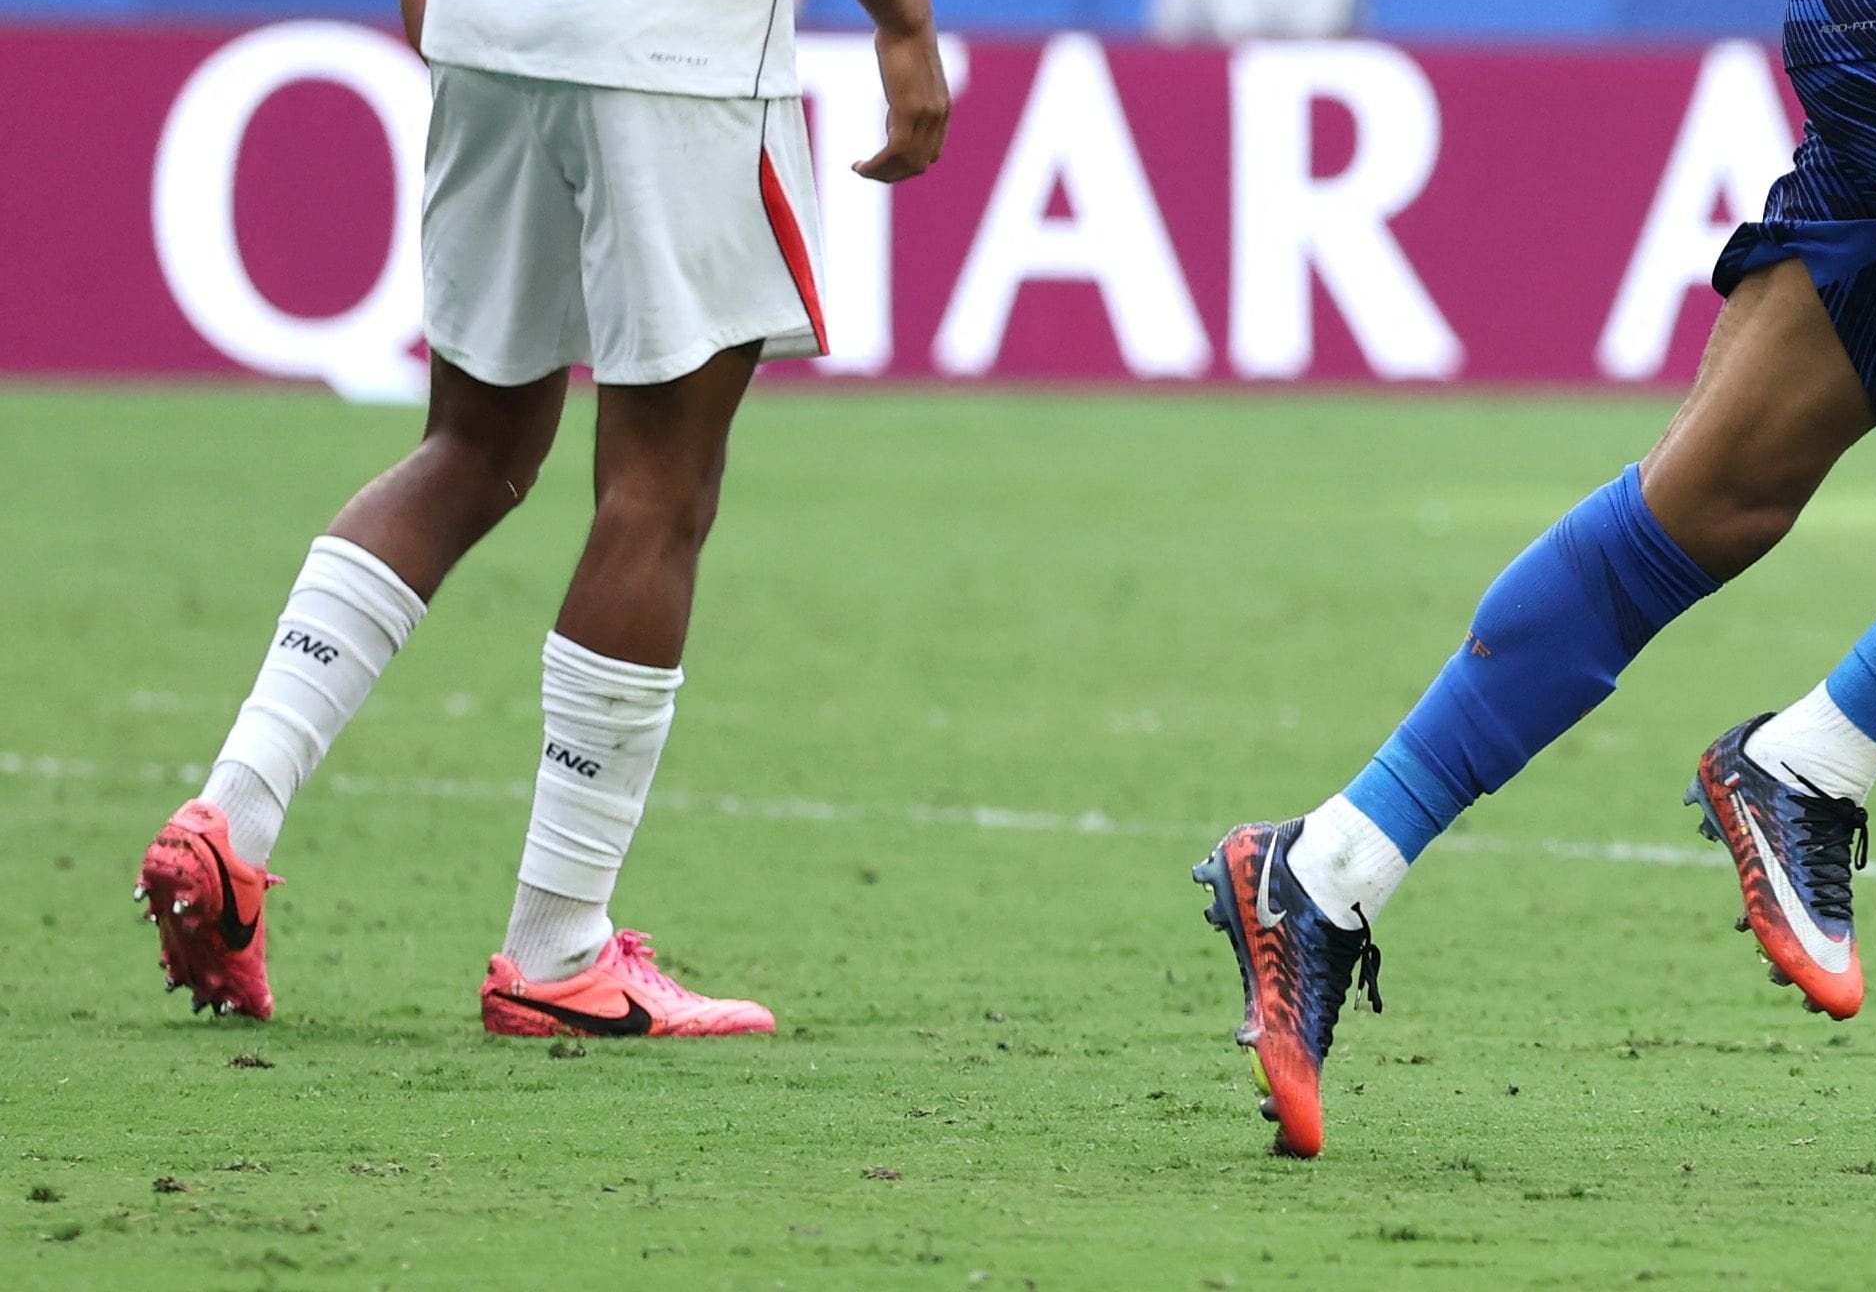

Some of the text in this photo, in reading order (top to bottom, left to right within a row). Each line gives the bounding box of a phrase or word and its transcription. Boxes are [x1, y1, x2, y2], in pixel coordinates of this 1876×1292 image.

[152, 17, 1465, 402] QTAR
[279, 629, 340, 667] ENG
[545, 741, 602, 779] ENG
